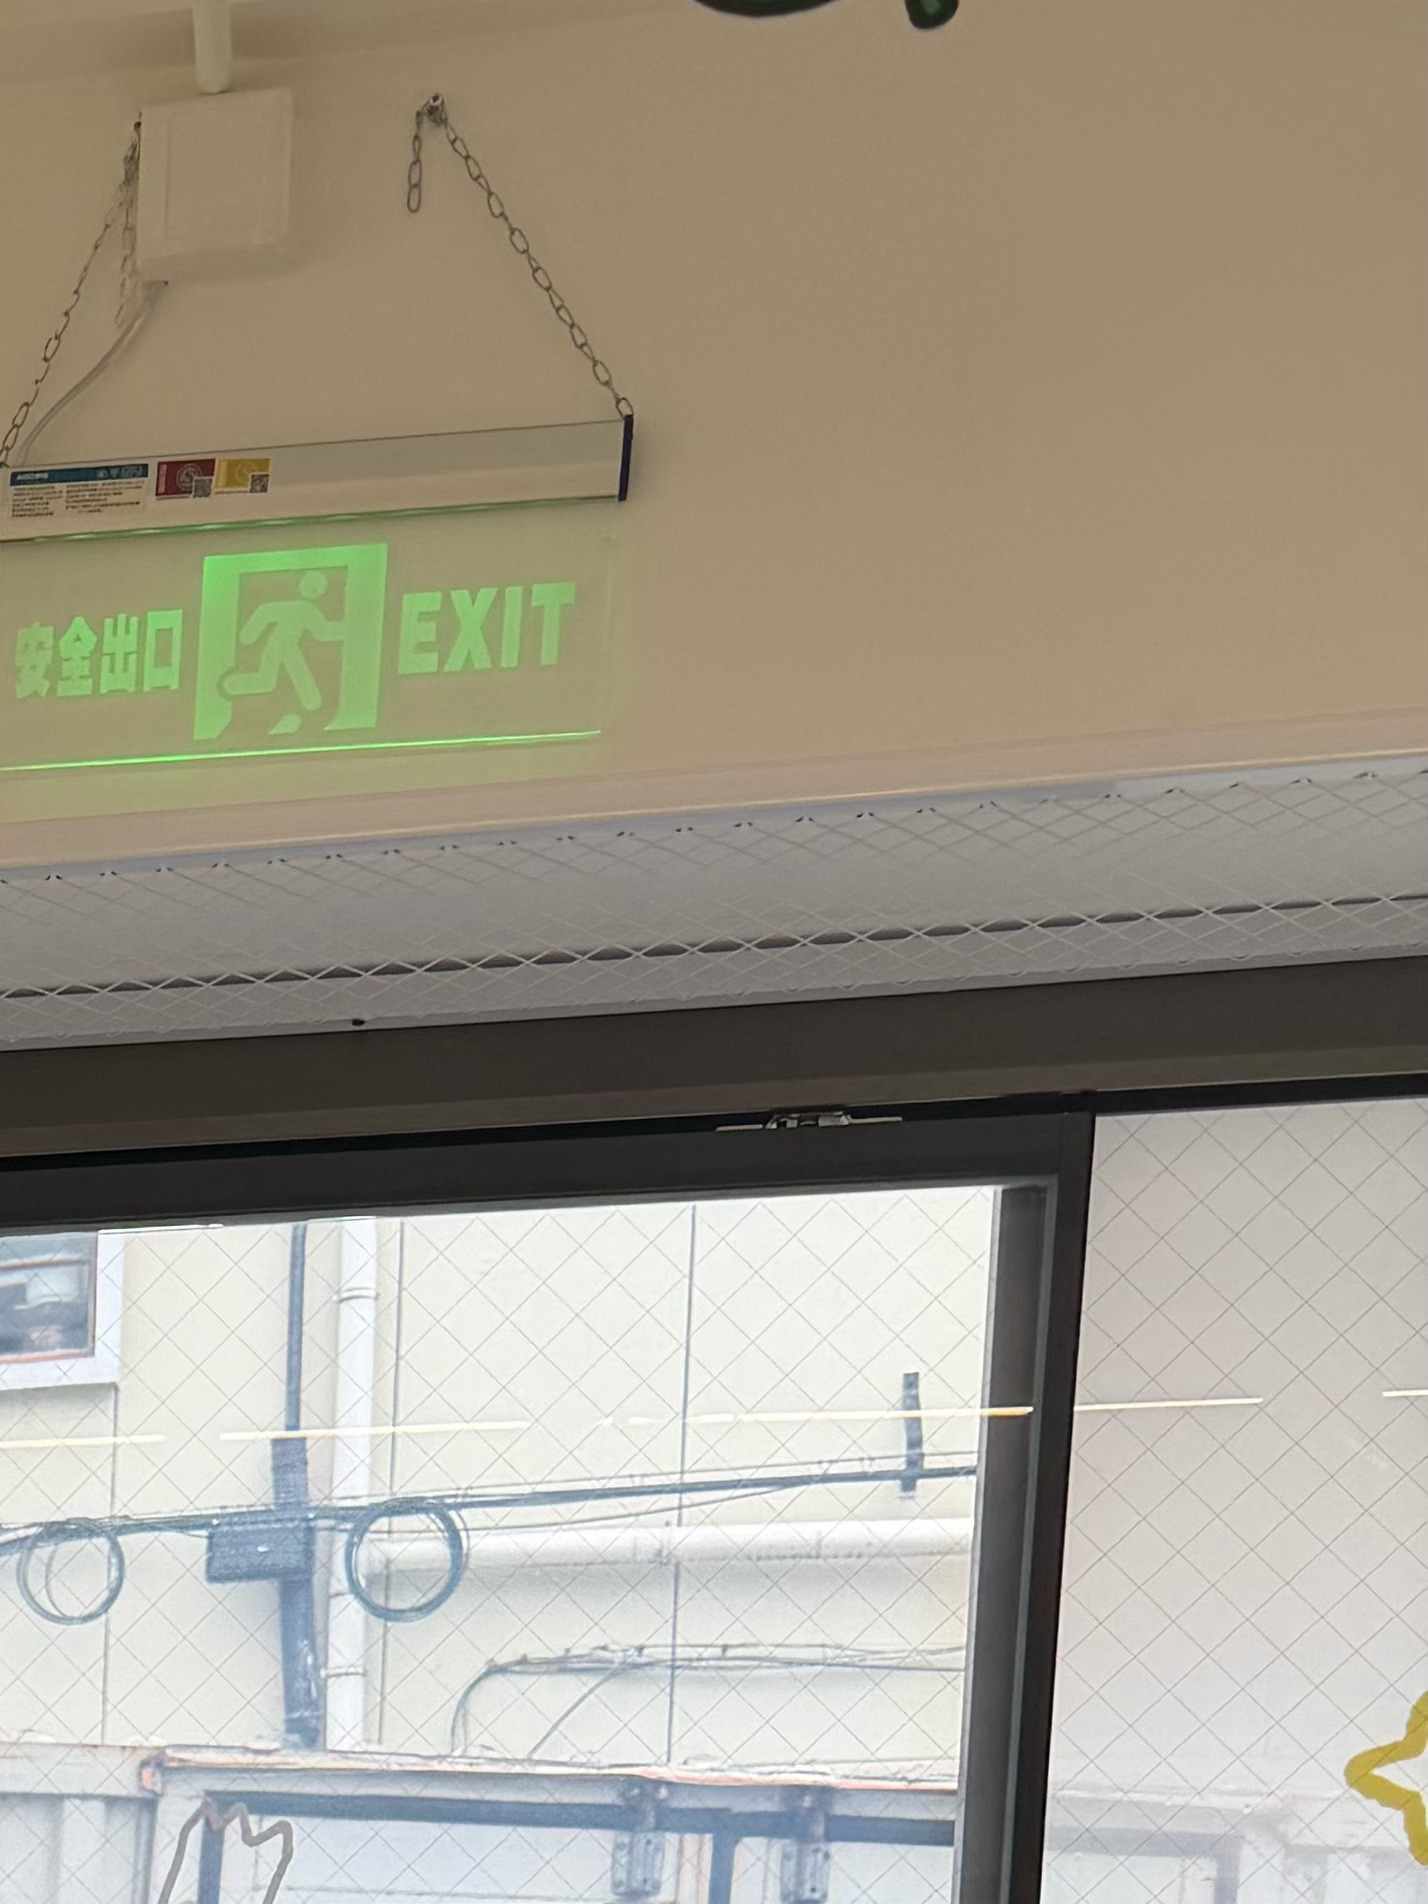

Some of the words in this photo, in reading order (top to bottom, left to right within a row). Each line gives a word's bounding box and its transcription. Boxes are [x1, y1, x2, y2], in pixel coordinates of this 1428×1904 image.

[15, 609, 183, 698] 安全出口
[398, 581, 576, 675] EXIT
